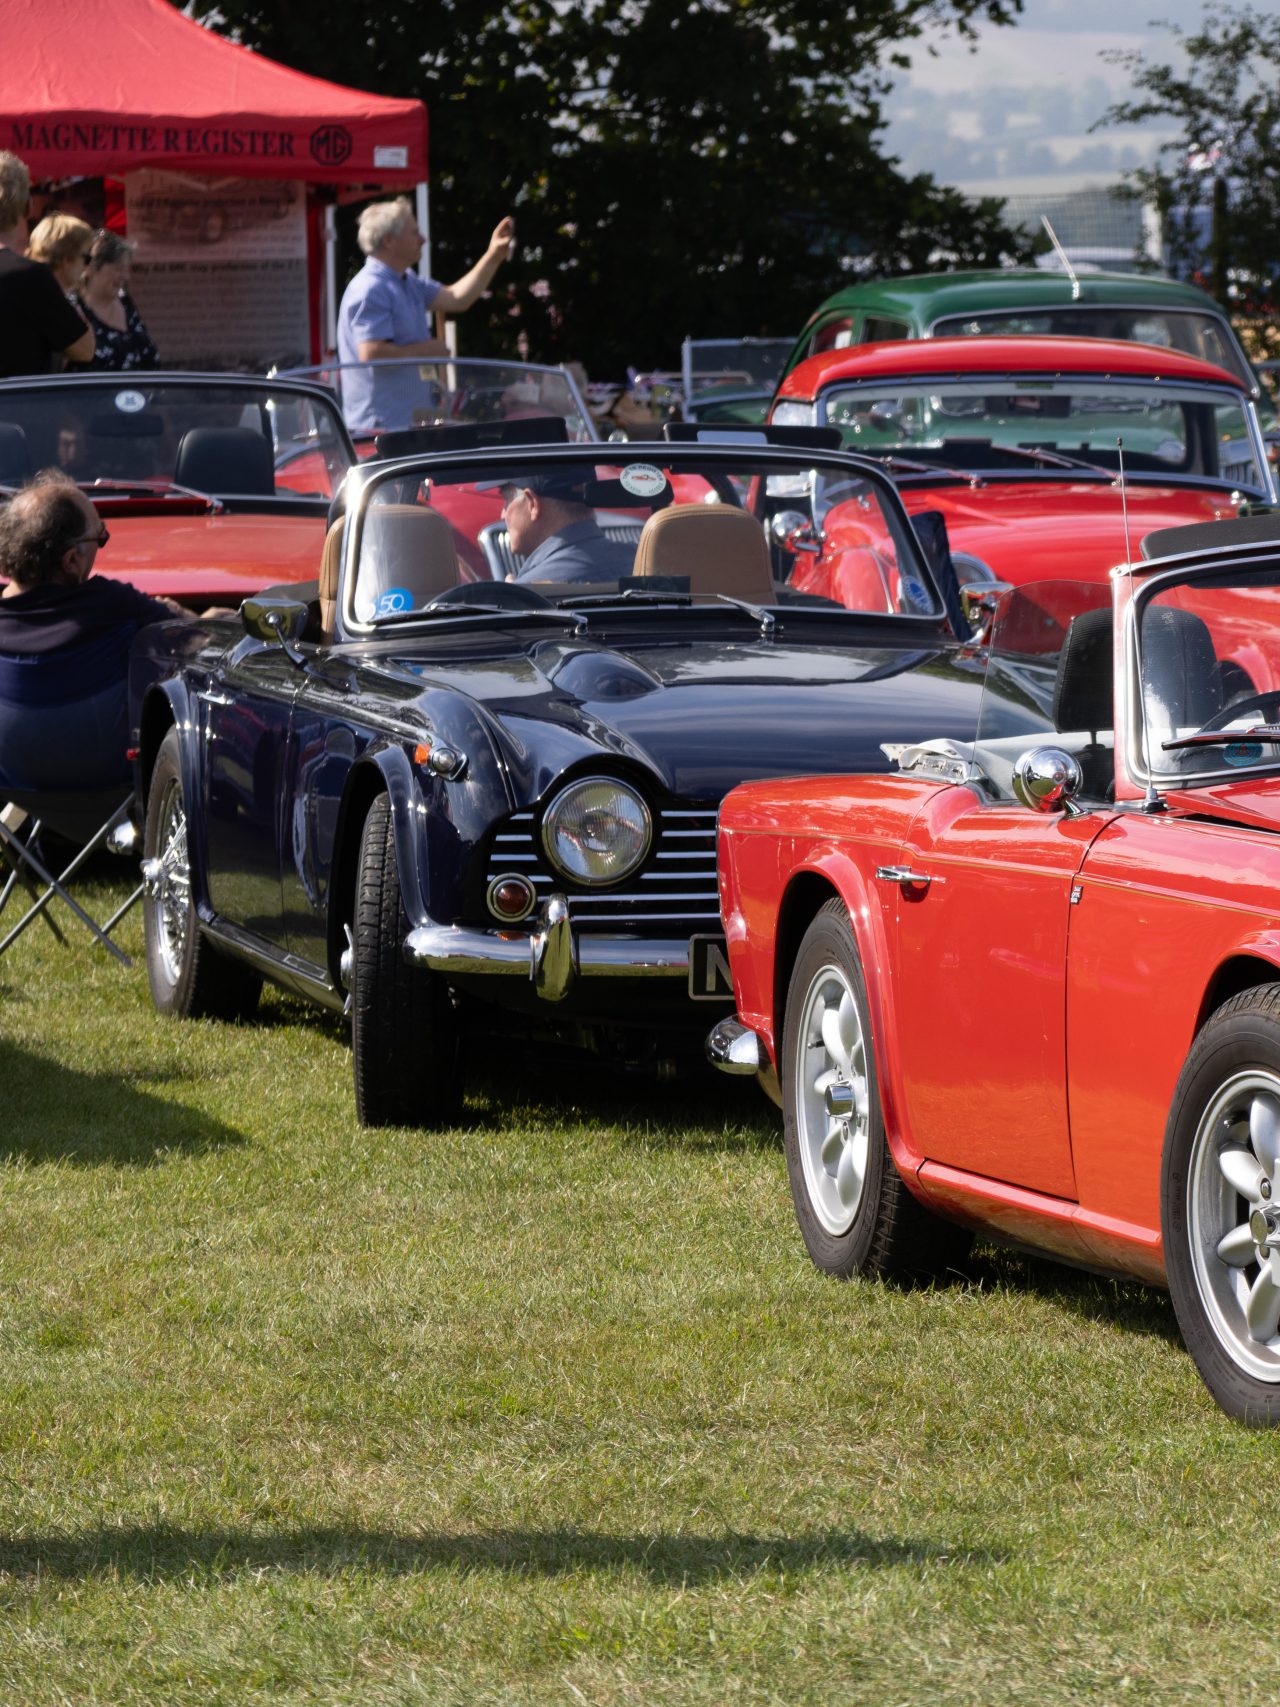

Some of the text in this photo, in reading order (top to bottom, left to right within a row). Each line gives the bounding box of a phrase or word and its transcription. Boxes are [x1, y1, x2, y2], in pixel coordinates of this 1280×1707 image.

[12, 123, 295, 157] MAGNETTE REGISTER
[313, 128, 349, 161] MG
[379, 593, 405, 614] 50
